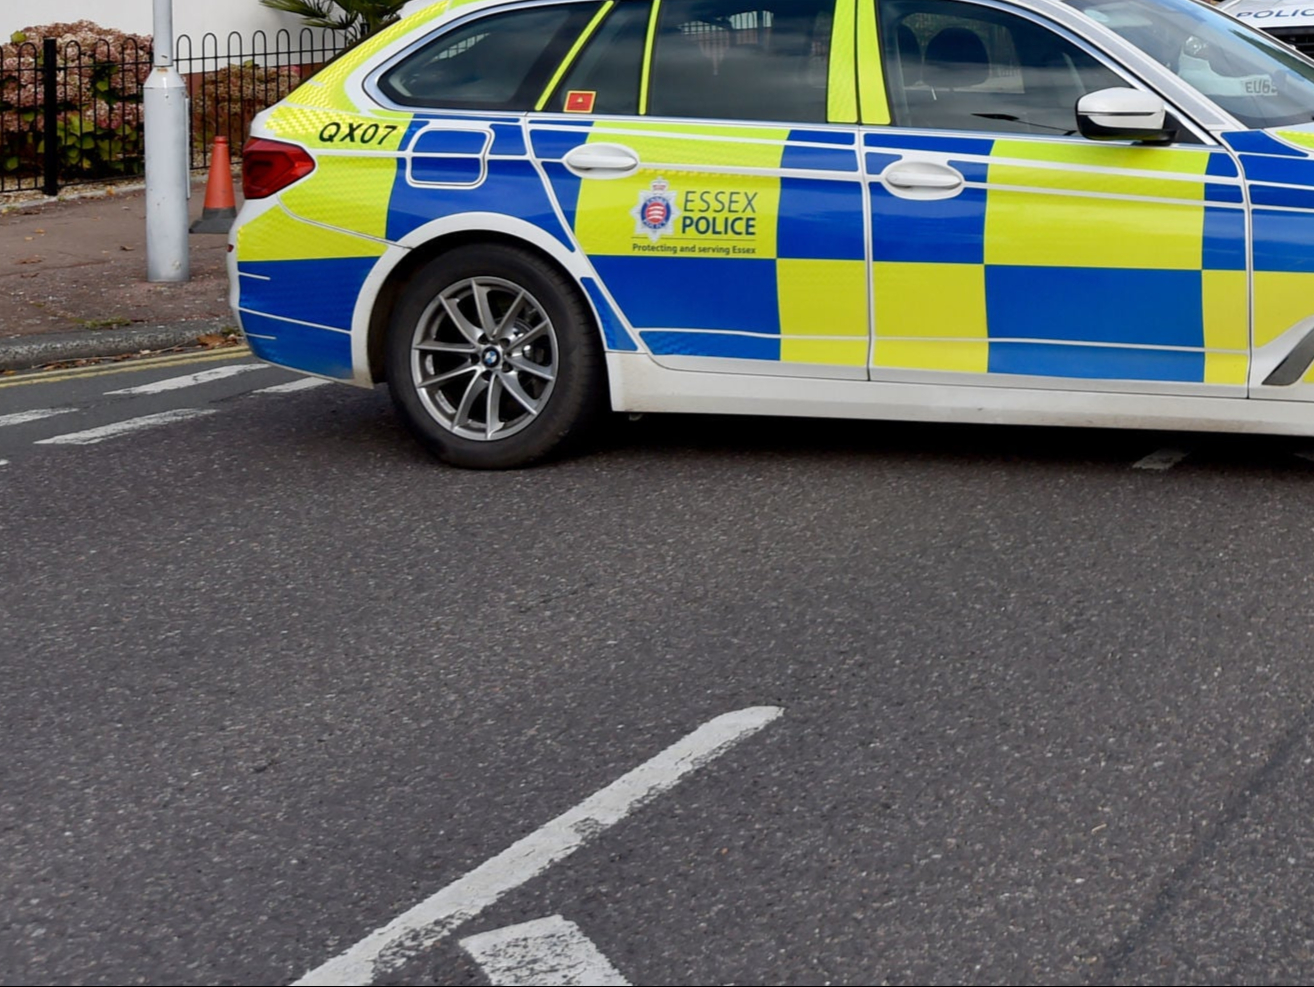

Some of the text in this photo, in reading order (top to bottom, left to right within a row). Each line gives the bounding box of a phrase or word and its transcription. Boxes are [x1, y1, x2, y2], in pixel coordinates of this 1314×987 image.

[318, 122, 398, 145] QX07
[683, 191, 758, 213] ESSEX
[682, 216, 756, 235] POLICE
[632, 244, 756, 255] Protecting and serving Essex
